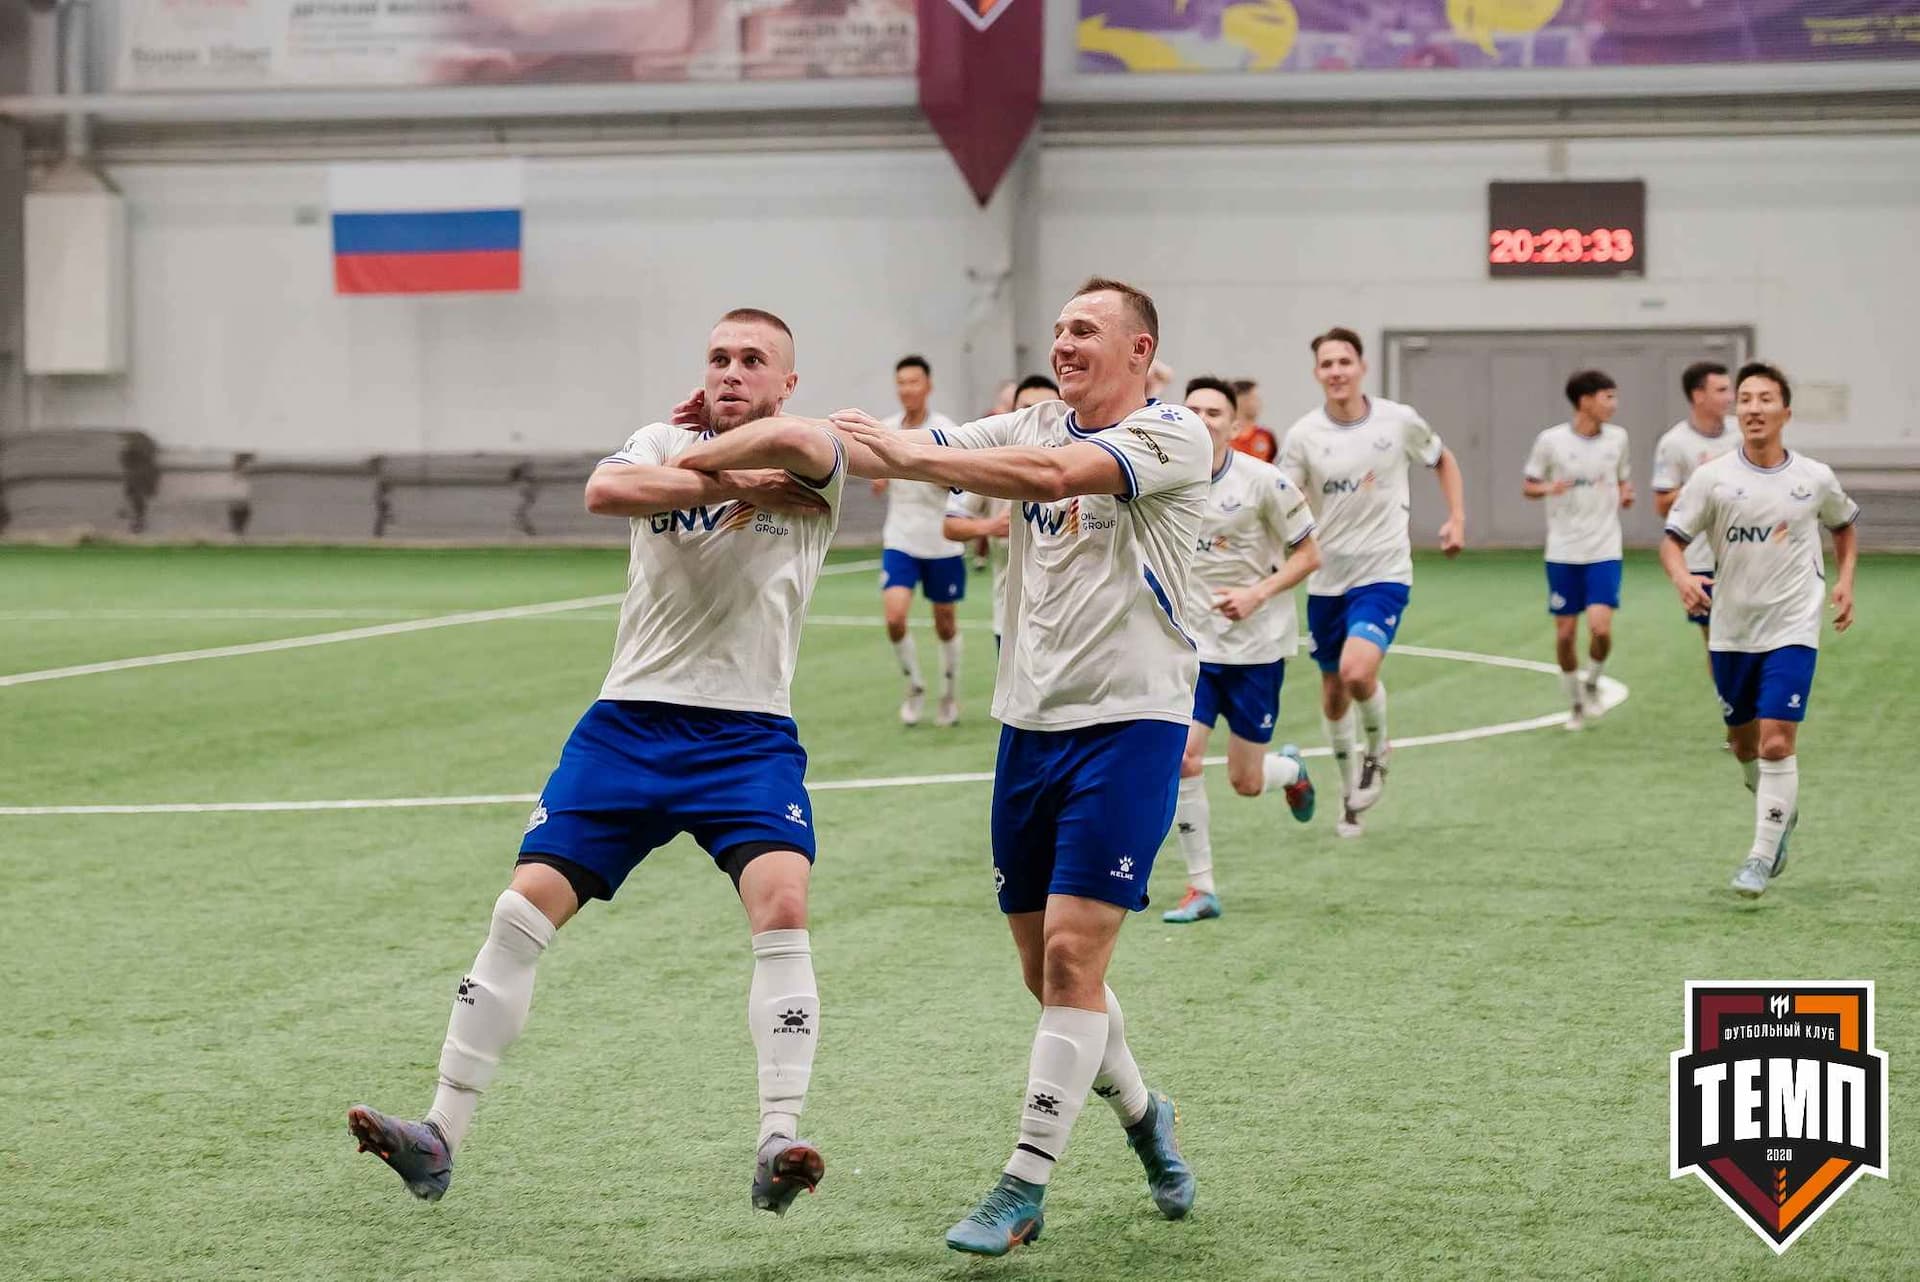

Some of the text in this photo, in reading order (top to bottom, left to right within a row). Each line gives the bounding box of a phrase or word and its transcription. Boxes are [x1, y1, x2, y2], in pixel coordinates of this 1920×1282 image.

[1490, 228, 1634, 263] 20:23:33
[651, 505, 727, 534] GNV
[756, 513, 773, 524] OIL
[1081, 512, 1097, 521] OIL
[755, 524, 789, 536] GROUP
[1082, 520, 1116, 530] GROUP
[1726, 526, 1772, 543] GNV
[773, 1026, 811, 1036] KELME
